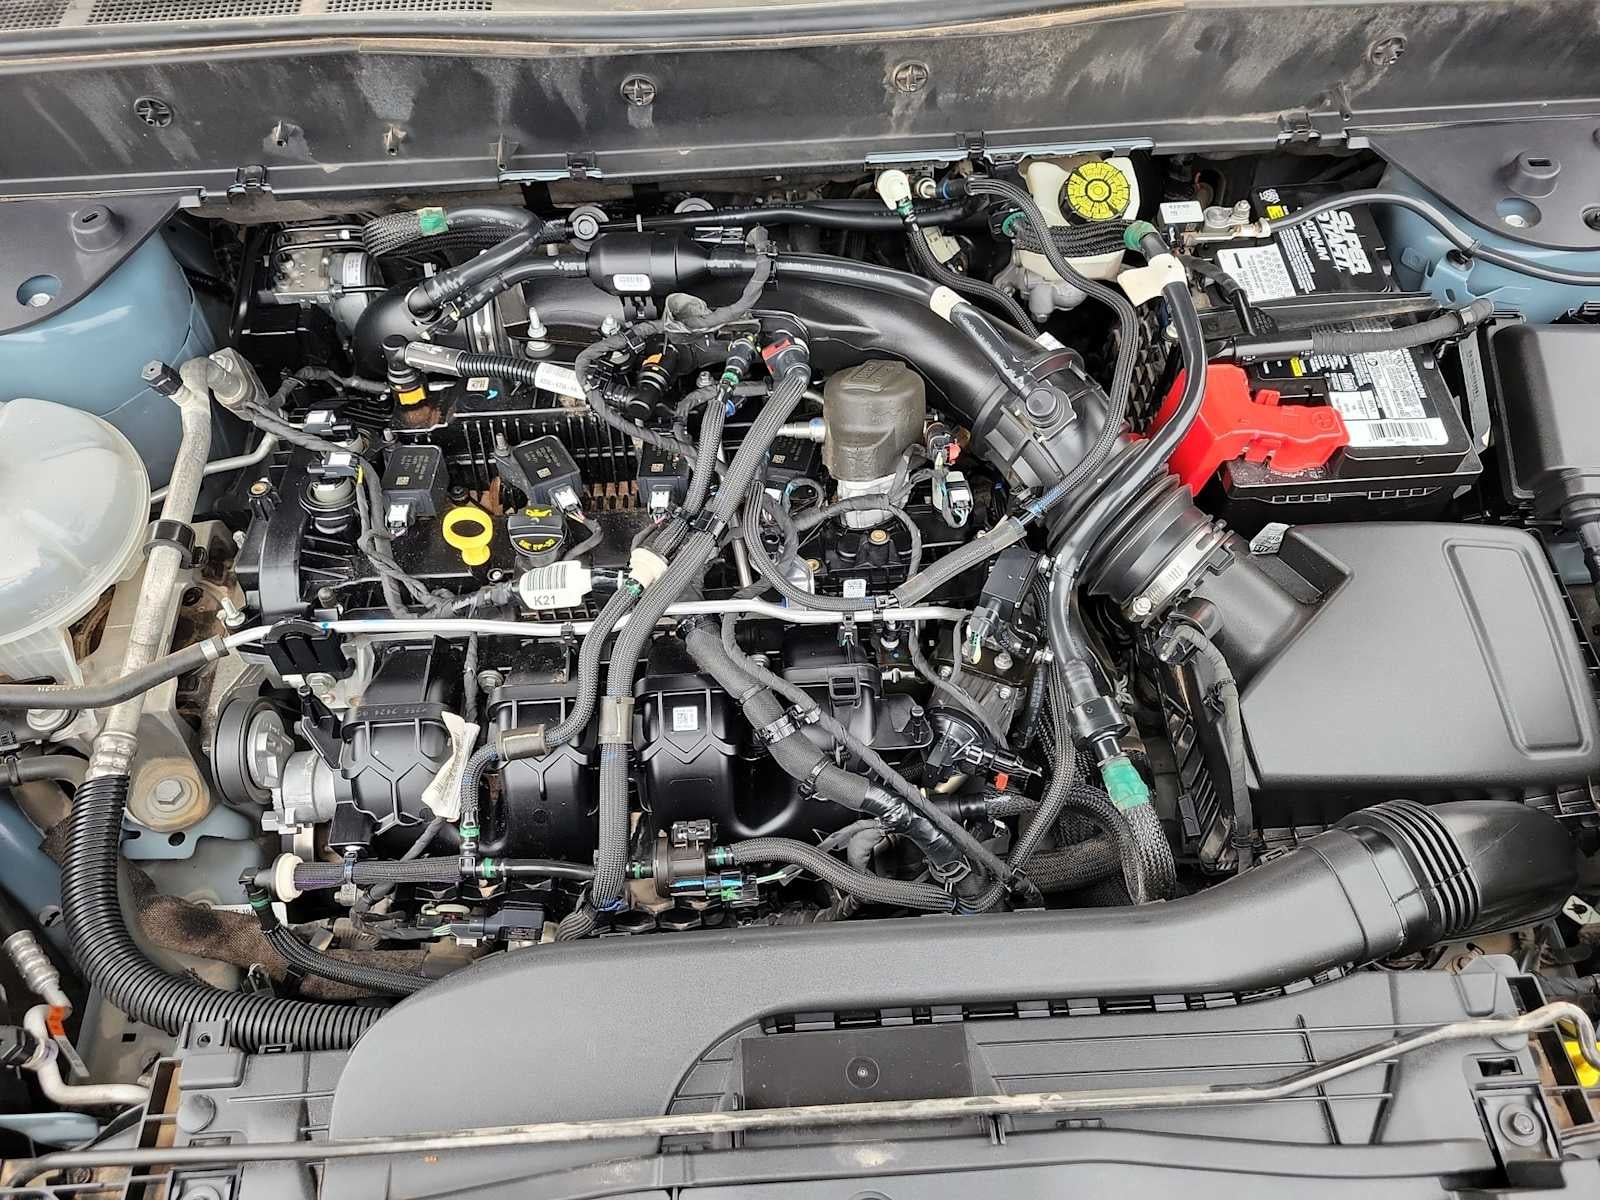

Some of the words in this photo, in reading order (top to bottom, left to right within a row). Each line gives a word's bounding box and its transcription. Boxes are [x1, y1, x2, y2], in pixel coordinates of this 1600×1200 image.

[1304, 219, 1331, 261] ATINUM
[1339, 210, 1373, 274] SUPER
[1400, 348, 1428, 399] ANGER/POISON
[534, 595, 556, 606] K21
